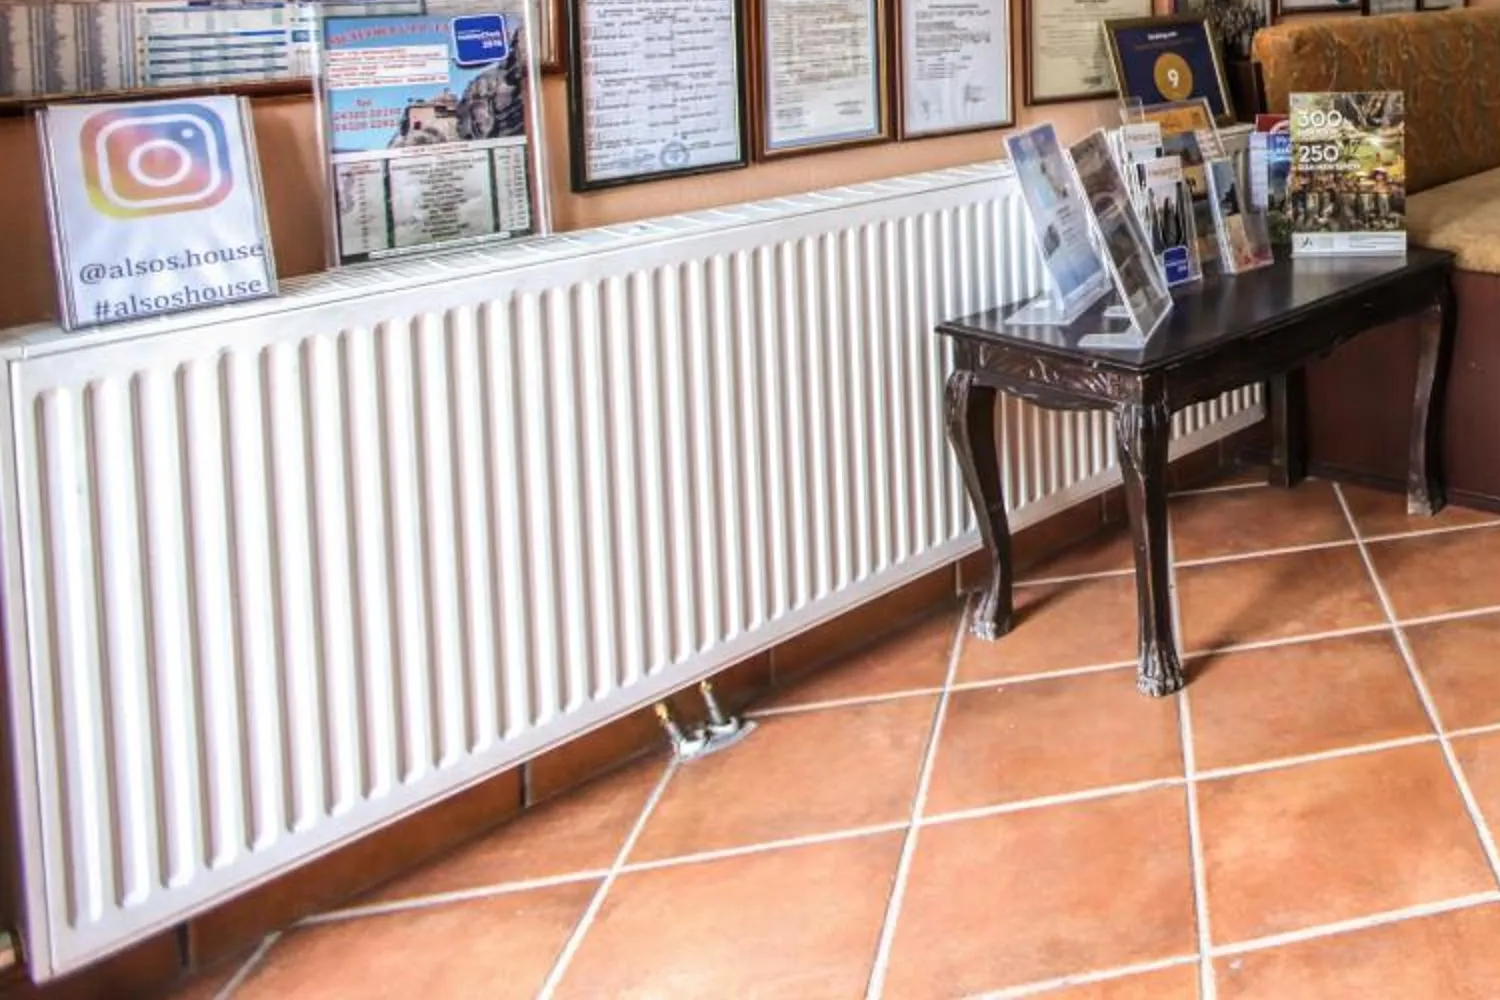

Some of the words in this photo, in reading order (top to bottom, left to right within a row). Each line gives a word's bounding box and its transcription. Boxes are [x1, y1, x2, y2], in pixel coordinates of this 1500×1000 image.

[1166, 68, 1179, 89] 9
[1299, 144, 1339, 163] 250
[79, 243, 264, 285] @alsos.house
[94, 278, 262, 321] #alsoshouse
